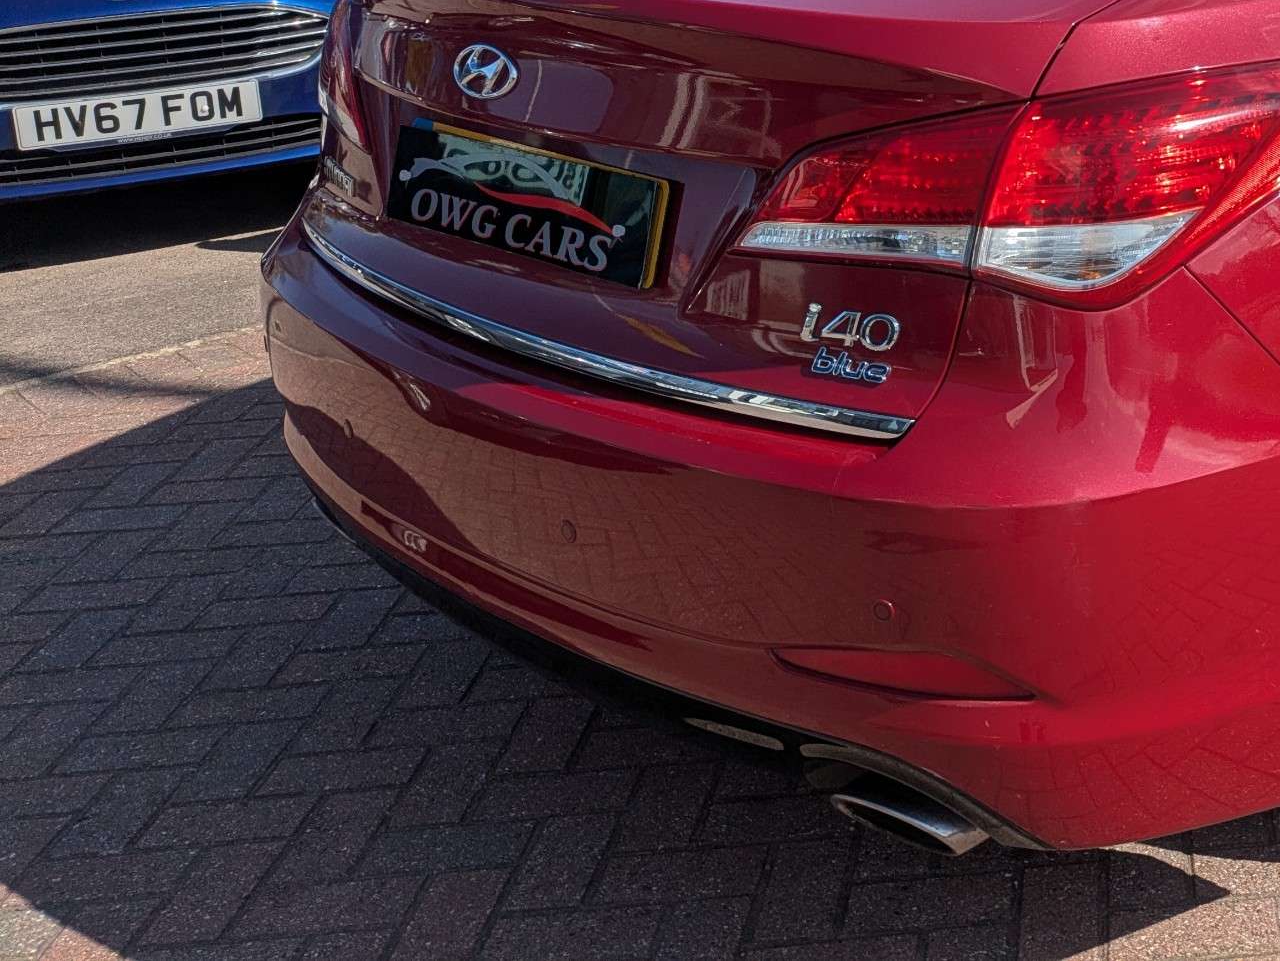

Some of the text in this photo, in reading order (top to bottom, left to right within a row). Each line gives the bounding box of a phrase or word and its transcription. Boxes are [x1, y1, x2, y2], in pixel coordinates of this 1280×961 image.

[33, 86, 244, 142] HV67 FOM
[410, 188, 613, 272] OWG CARS
[800, 302, 901, 352] i40
[811, 346, 892, 384] blue
